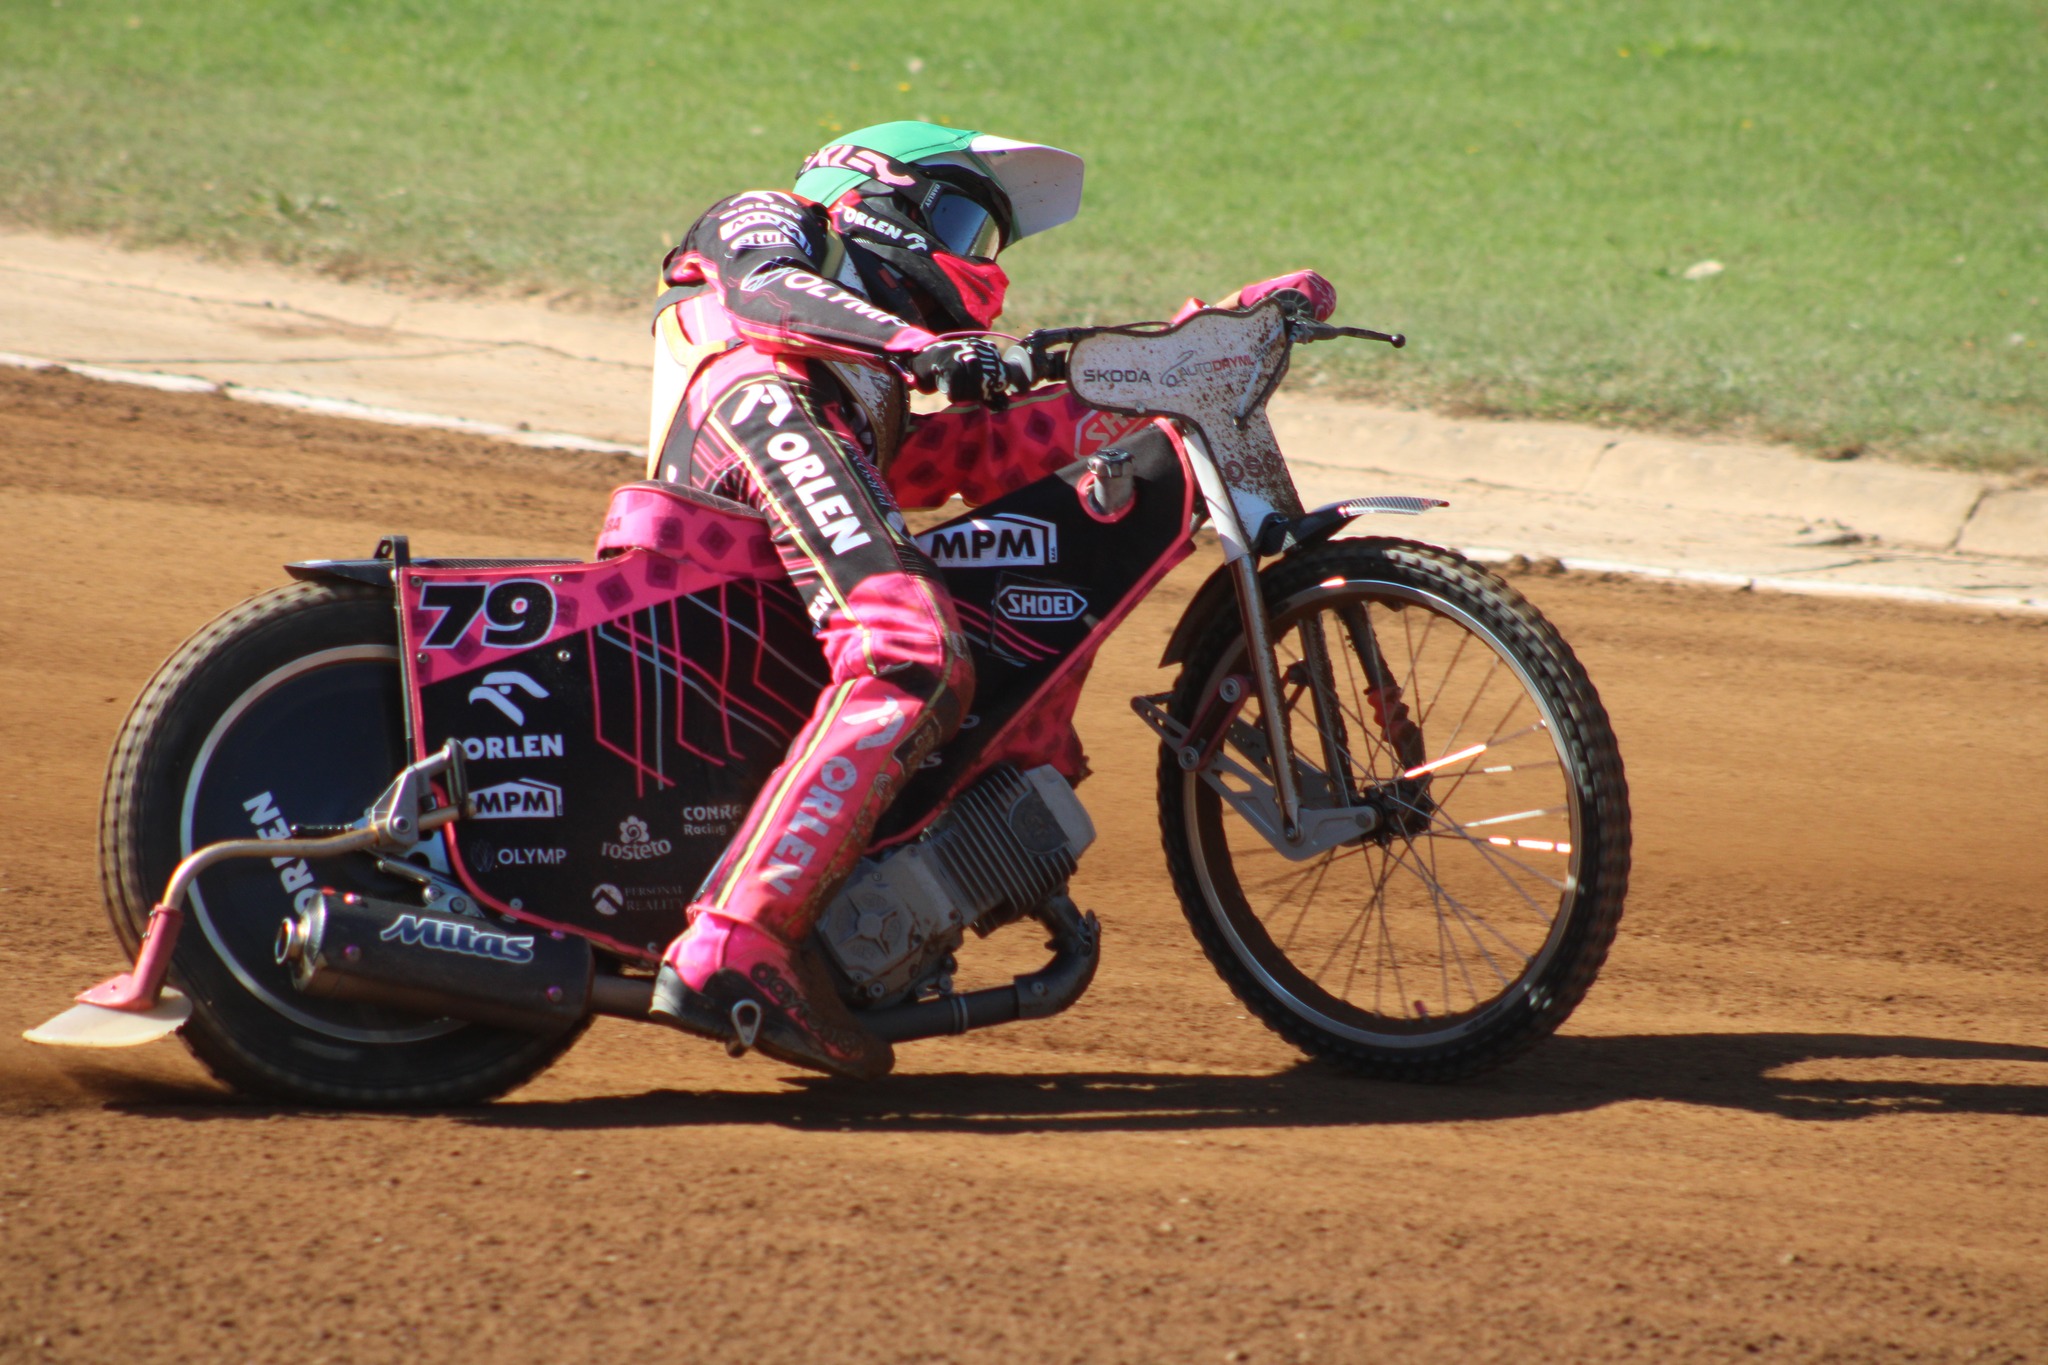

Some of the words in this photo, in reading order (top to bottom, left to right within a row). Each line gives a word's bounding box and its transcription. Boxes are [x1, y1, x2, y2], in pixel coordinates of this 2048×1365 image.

[844, 205, 902, 239] ORLEN
[785, 272, 910, 328] OLYMP
[1083, 369, 1152, 383] SKODA
[767, 432, 871, 556] ORLEN
[930, 529, 1037, 559] MPM
[420, 578, 557, 650] 79
[1008, 593, 1074, 615] SHOEI
[463, 734, 564, 760] ORLEN
[476, 791, 549, 813] MPM
[759, 755, 858, 897] ORLEN
[498, 848, 567, 865] OLYMP
[601, 839, 671, 860] rosteto
[380, 914, 534, 963] Mitas
